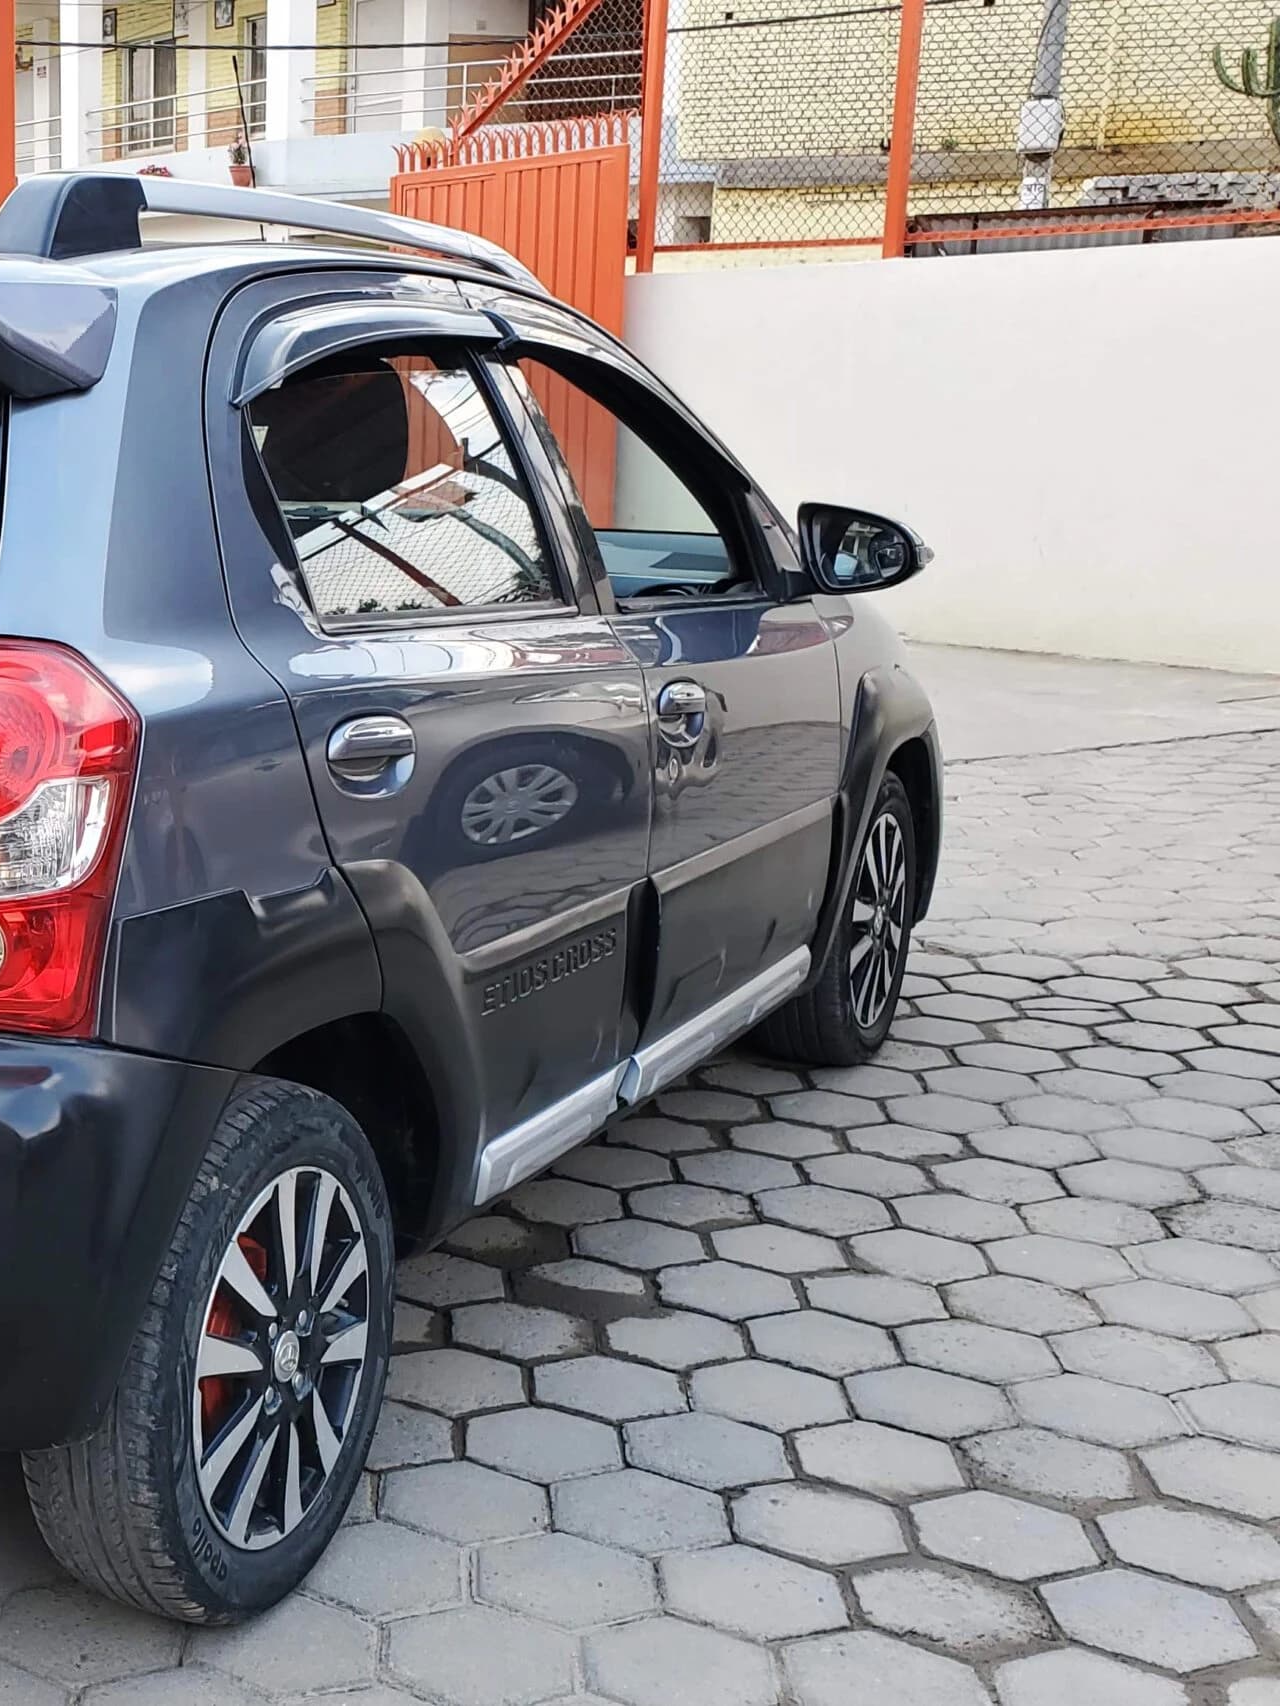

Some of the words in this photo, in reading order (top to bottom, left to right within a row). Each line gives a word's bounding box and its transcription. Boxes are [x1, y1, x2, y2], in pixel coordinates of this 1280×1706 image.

[481, 959, 548, 1016] ETIOS
[551, 928, 616, 983] CROSS
[191, 1516, 228, 1582] apollo
